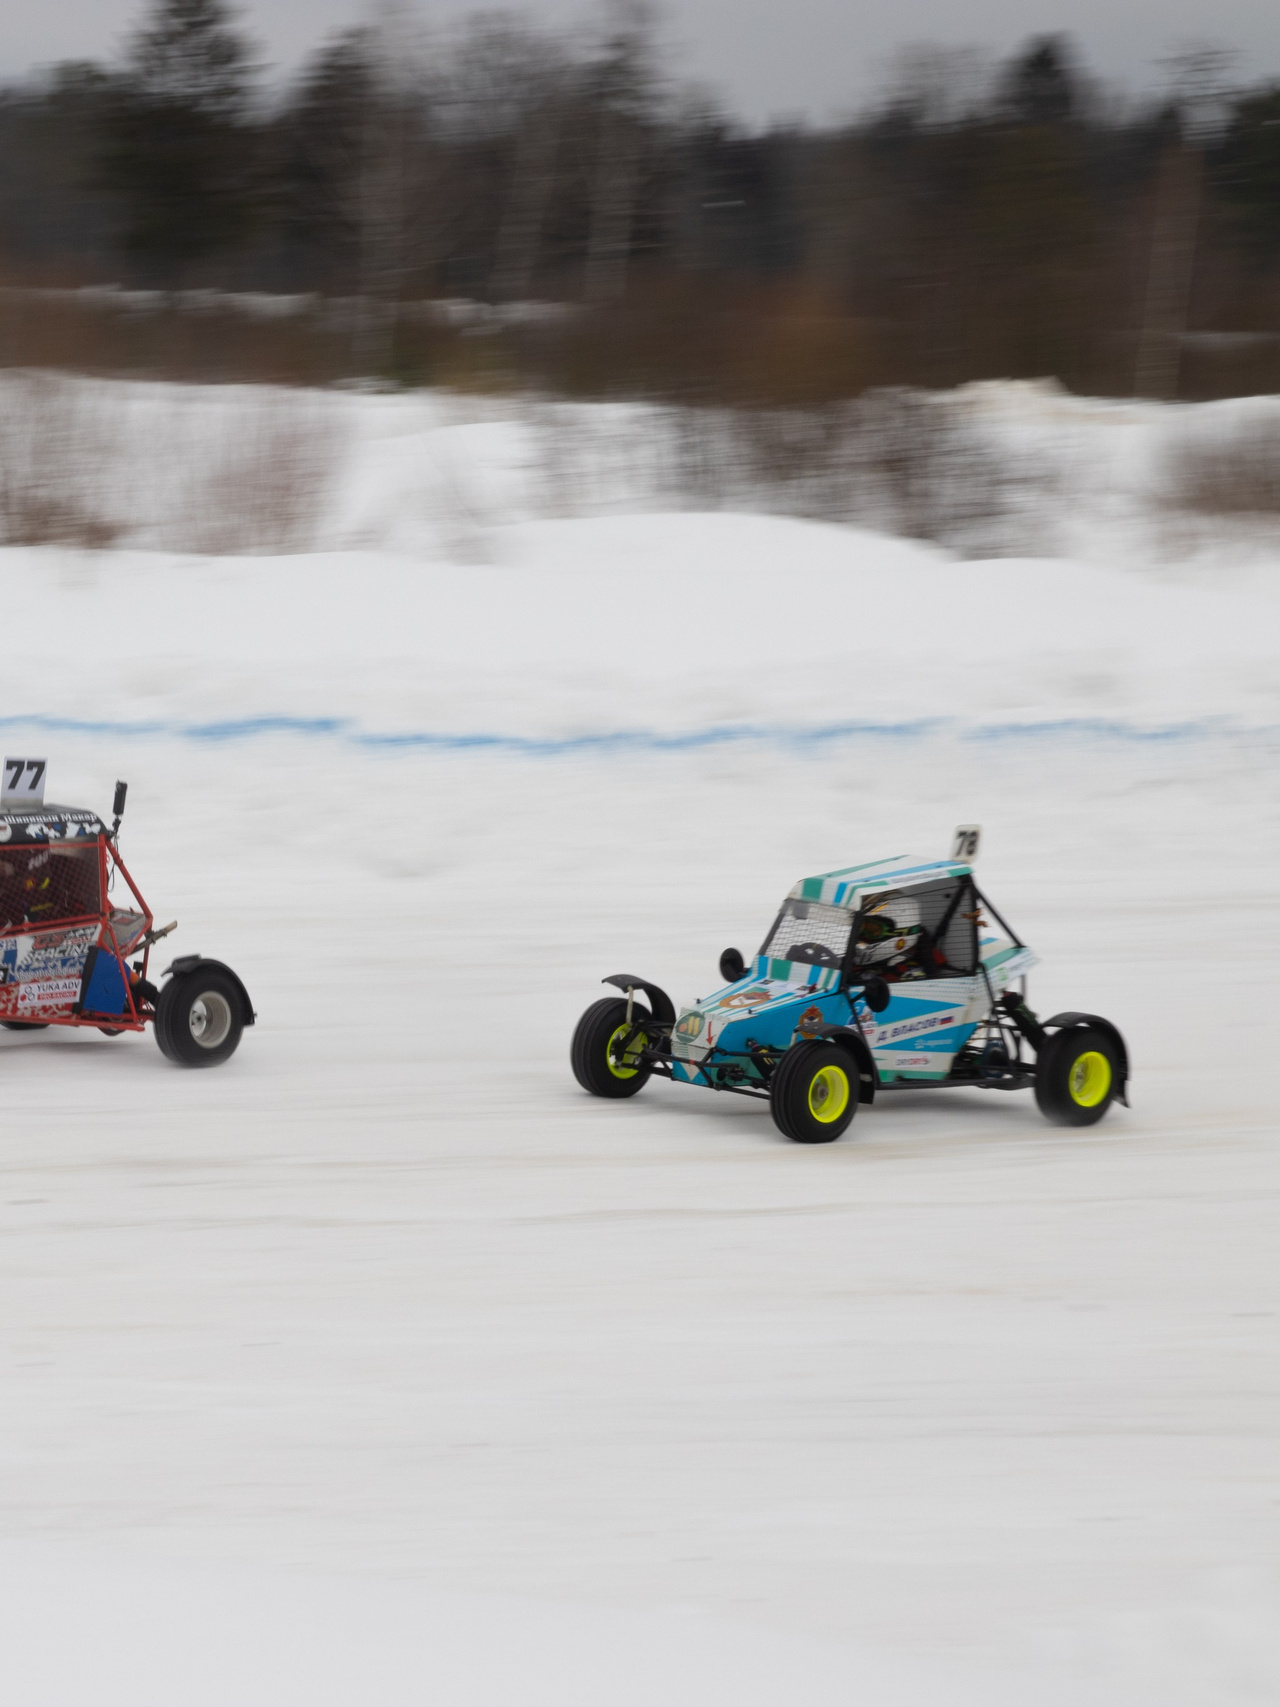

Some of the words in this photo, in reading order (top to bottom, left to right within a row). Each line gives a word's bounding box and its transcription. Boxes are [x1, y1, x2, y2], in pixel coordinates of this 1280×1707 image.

[5, 760, 46, 790] 77
[956, 831, 979, 856] 78
[37, 982, 61, 992] YUKA
[61, 980, 80, 990] ADV
[890, 1017, 938, 1037] ВЛАСОВ
